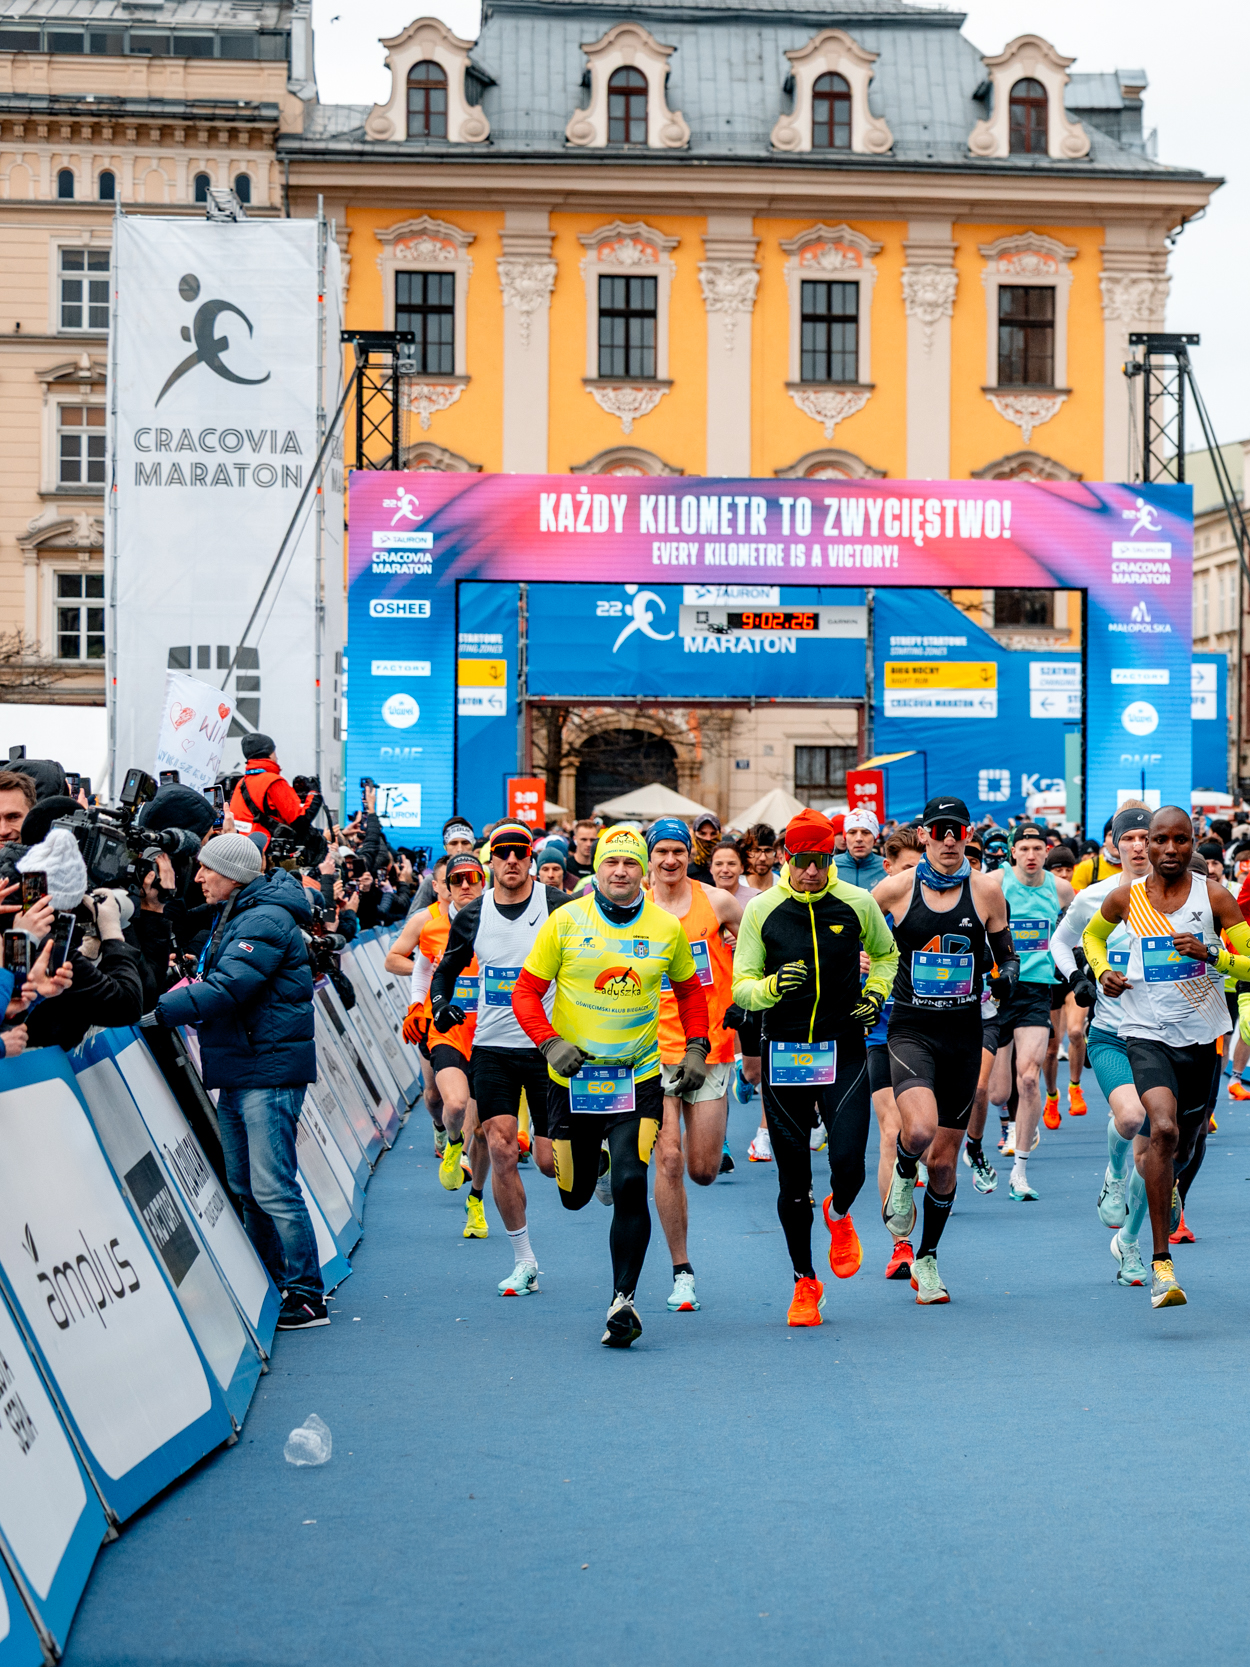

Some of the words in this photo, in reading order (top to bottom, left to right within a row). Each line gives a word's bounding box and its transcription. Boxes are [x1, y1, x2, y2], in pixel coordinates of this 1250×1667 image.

[134, 428, 303, 455] CRACOVIA
[134, 462, 302, 489] MARATON
[539, 486, 627, 534] KAŻDY
[639, 494, 767, 536] KILOMETR
[779, 497, 812, 537] TO
[823, 497, 1012, 547] ZWYCIĘSTWO!
[372, 551, 433, 563] CRACOVIA
[652, 541, 699, 566] EVERY
[705, 541, 785, 567] KILOMETRE
[790, 543, 806, 567] IS
[811, 544, 822, 567] A
[827, 543, 900, 568] VICTORY!
[372, 563, 432, 574] MARATON
[1111, 562, 1171, 573] CRACOVIA
[1111, 573, 1171, 584] MARATON
[596, 601, 623, 616] 22
[716, 585, 771, 599] TAURON
[373, 603, 427, 614] OSHEE
[1108, 623, 1172, 633] MAŁOPOLSKA
[683, 636, 797, 653] MARATON
[1014, 930, 1039, 939] 109
[1167, 952, 1182, 962] 4
[936, 968, 949, 979] 3
[456, 988, 473, 997] 81
[594, 983, 641, 1000] zadyszka
[791, 1053, 813, 1065] 10
[588, 1081, 615, 1094] 60
[143, 1185, 182, 1250] FACTORY
[37, 1229, 140, 1331] amplus
